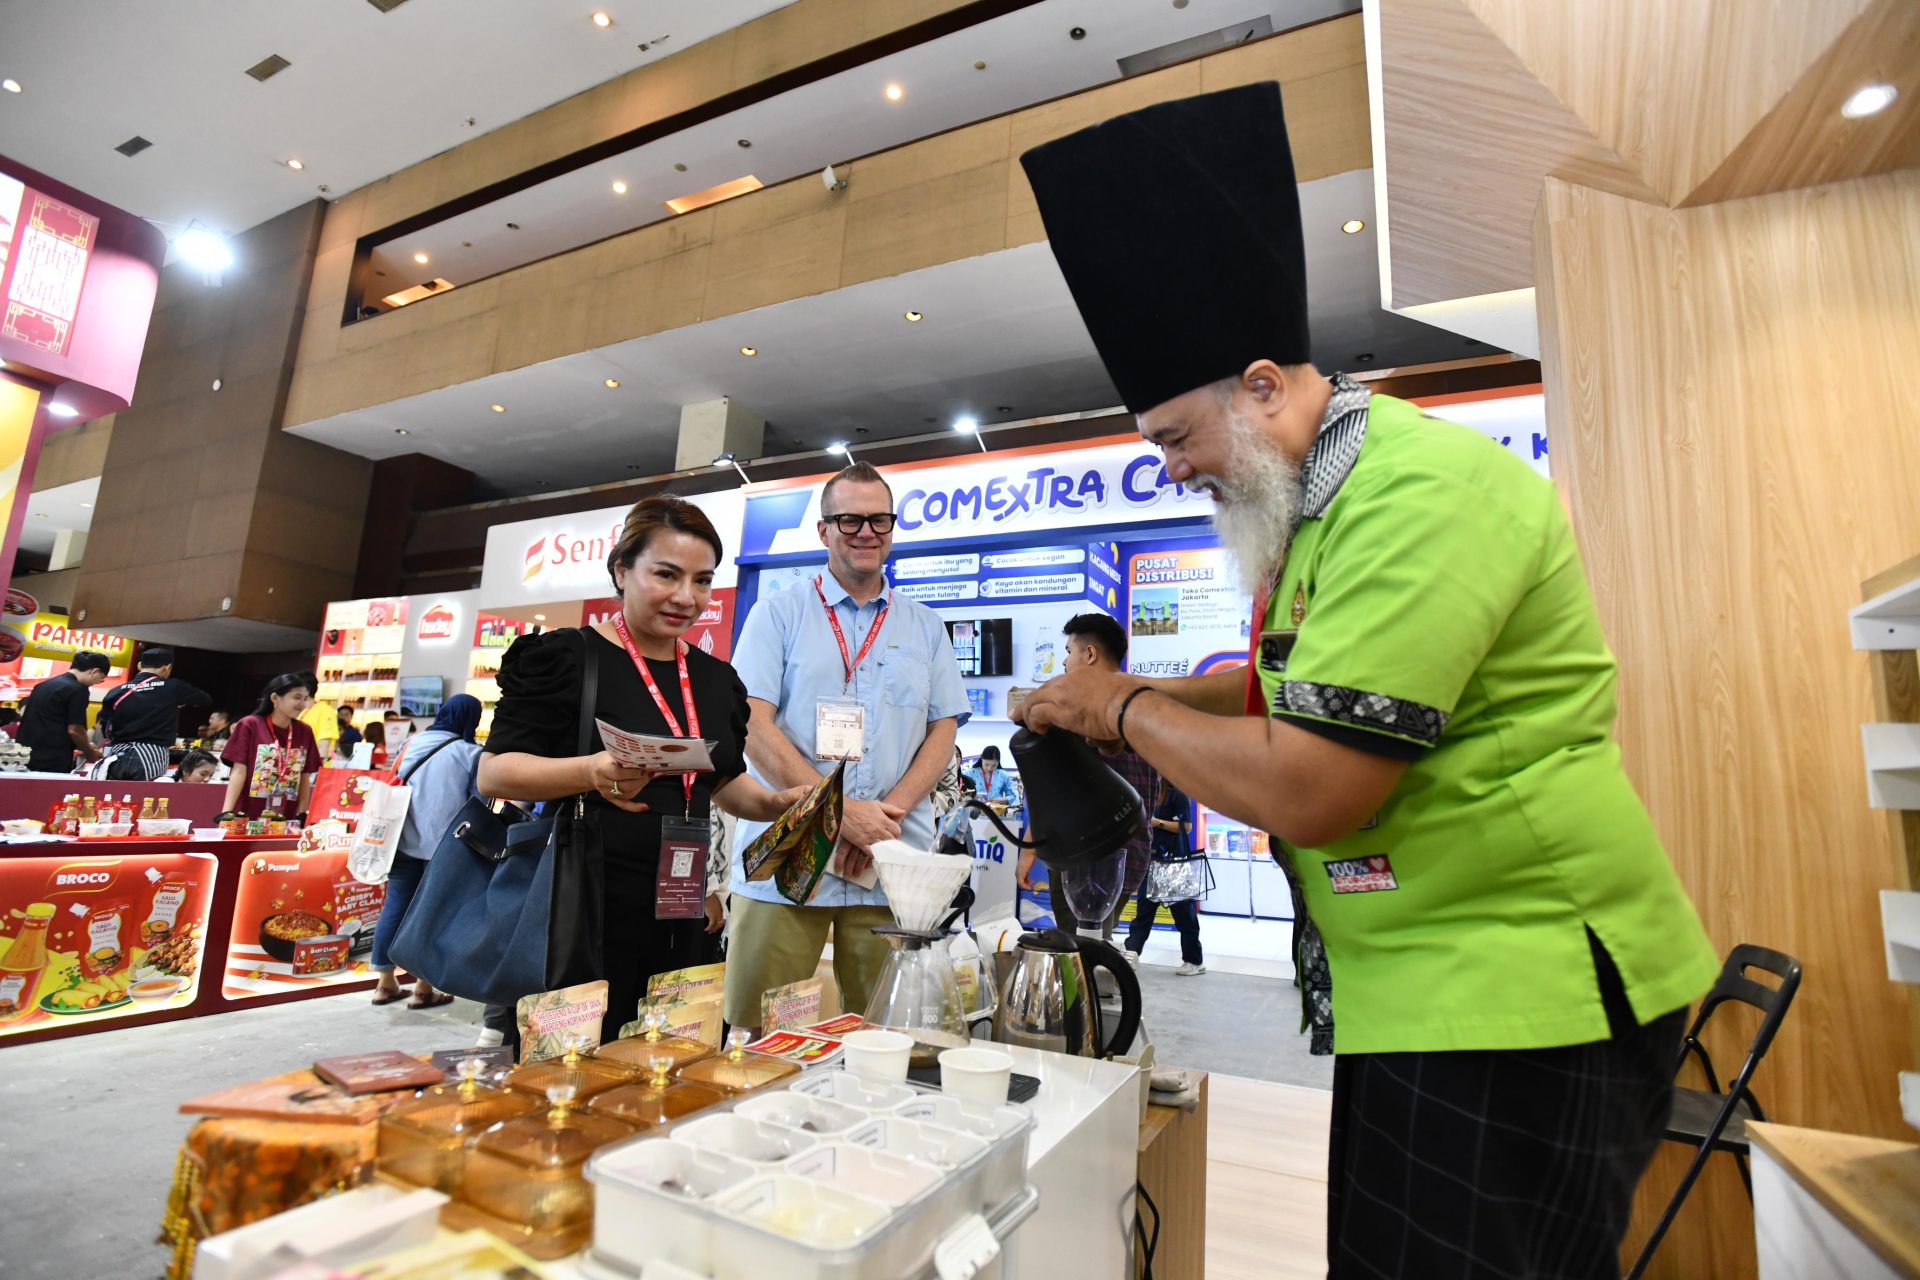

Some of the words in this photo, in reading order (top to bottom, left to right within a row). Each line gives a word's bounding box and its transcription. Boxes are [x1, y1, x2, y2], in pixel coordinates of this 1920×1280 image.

[897, 467, 1105, 530] COMEXTRA
[1136, 557, 1178, 571] PUSAT
[1034, 576, 1077, 585] kandungan
[1136, 568, 1214, 583] DISTRIBUSI
[936, 583, 967, 592] menjaga
[995, 587, 1023, 595] vitamin
[1038, 584, 1068, 592] mineral
[33, 622, 124, 652] PAMMA
[1327, 859, 1369, 877] 100%
[56, 872, 110, 885] BROCO
[344, 891, 375, 904] CRISPY
[337, 902, 358, 914] BABY
